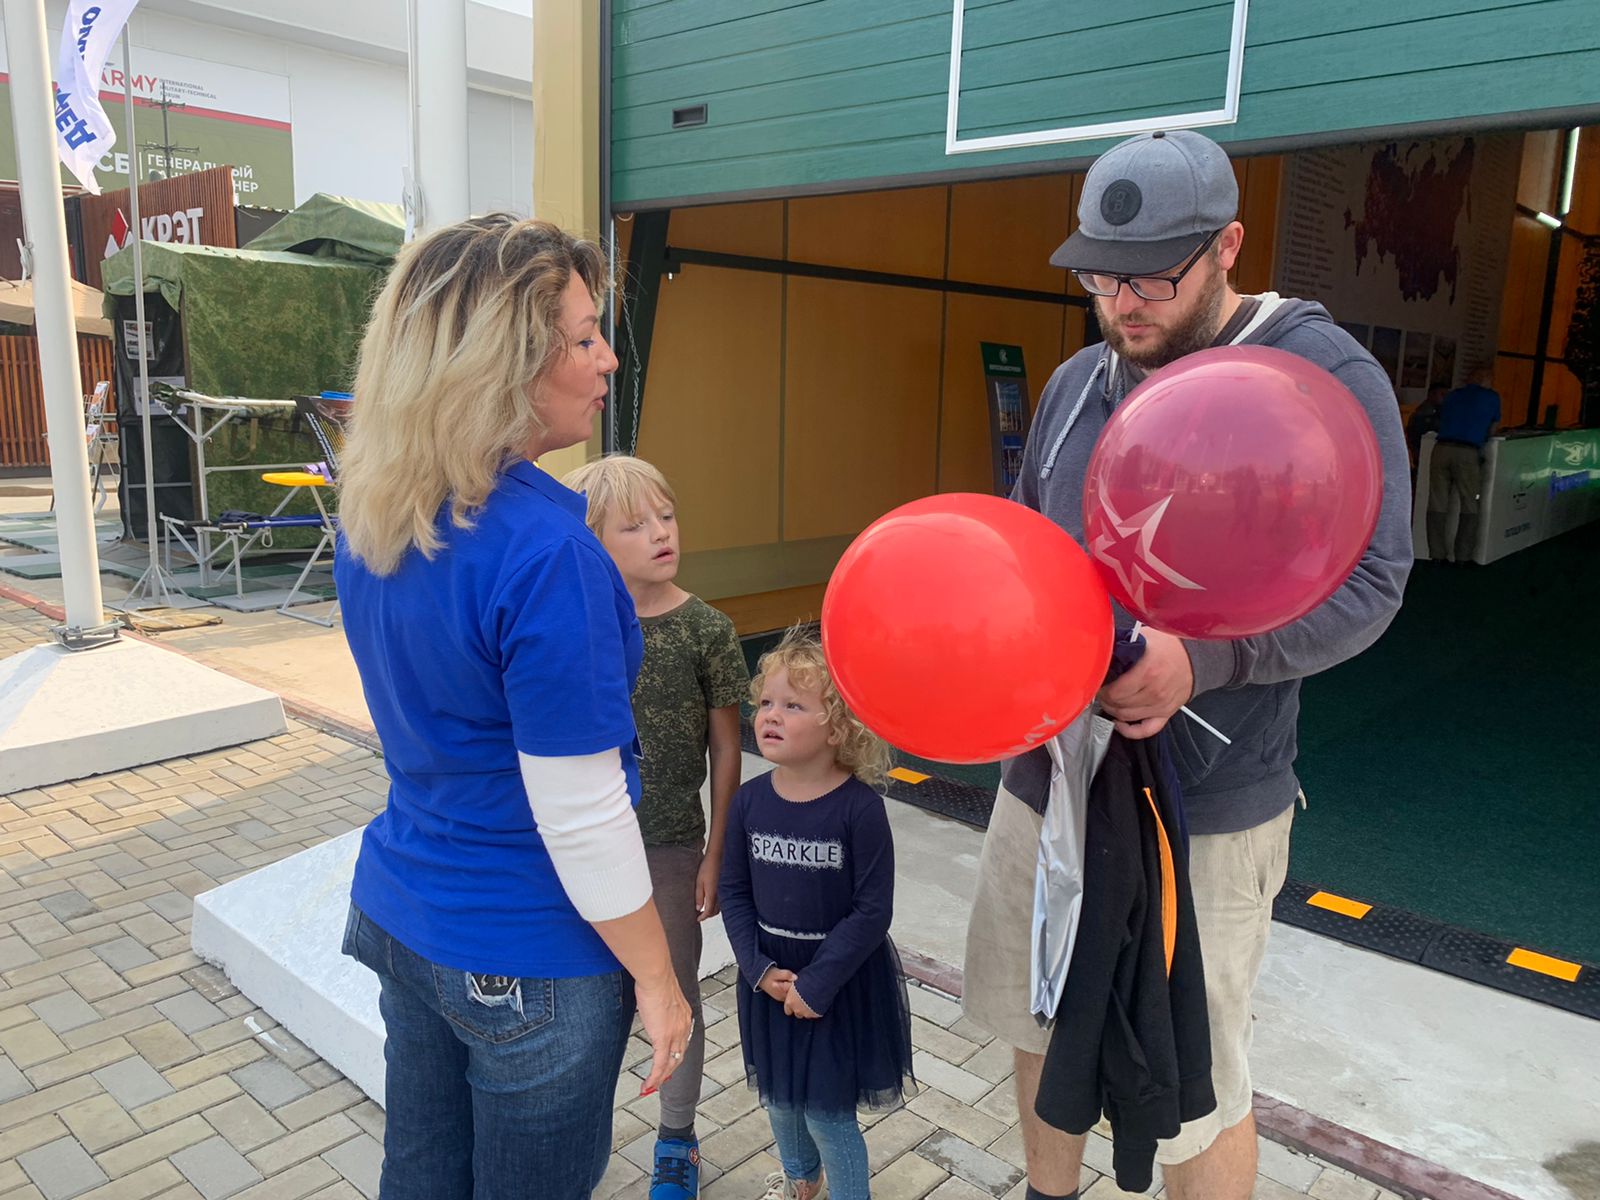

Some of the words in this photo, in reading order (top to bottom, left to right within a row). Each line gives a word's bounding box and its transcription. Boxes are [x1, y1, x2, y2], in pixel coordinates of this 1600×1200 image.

[101, 69, 158, 93] ARMY
[141, 207, 204, 246] КРЭТ
[752, 836, 839, 864] SPARKLE
